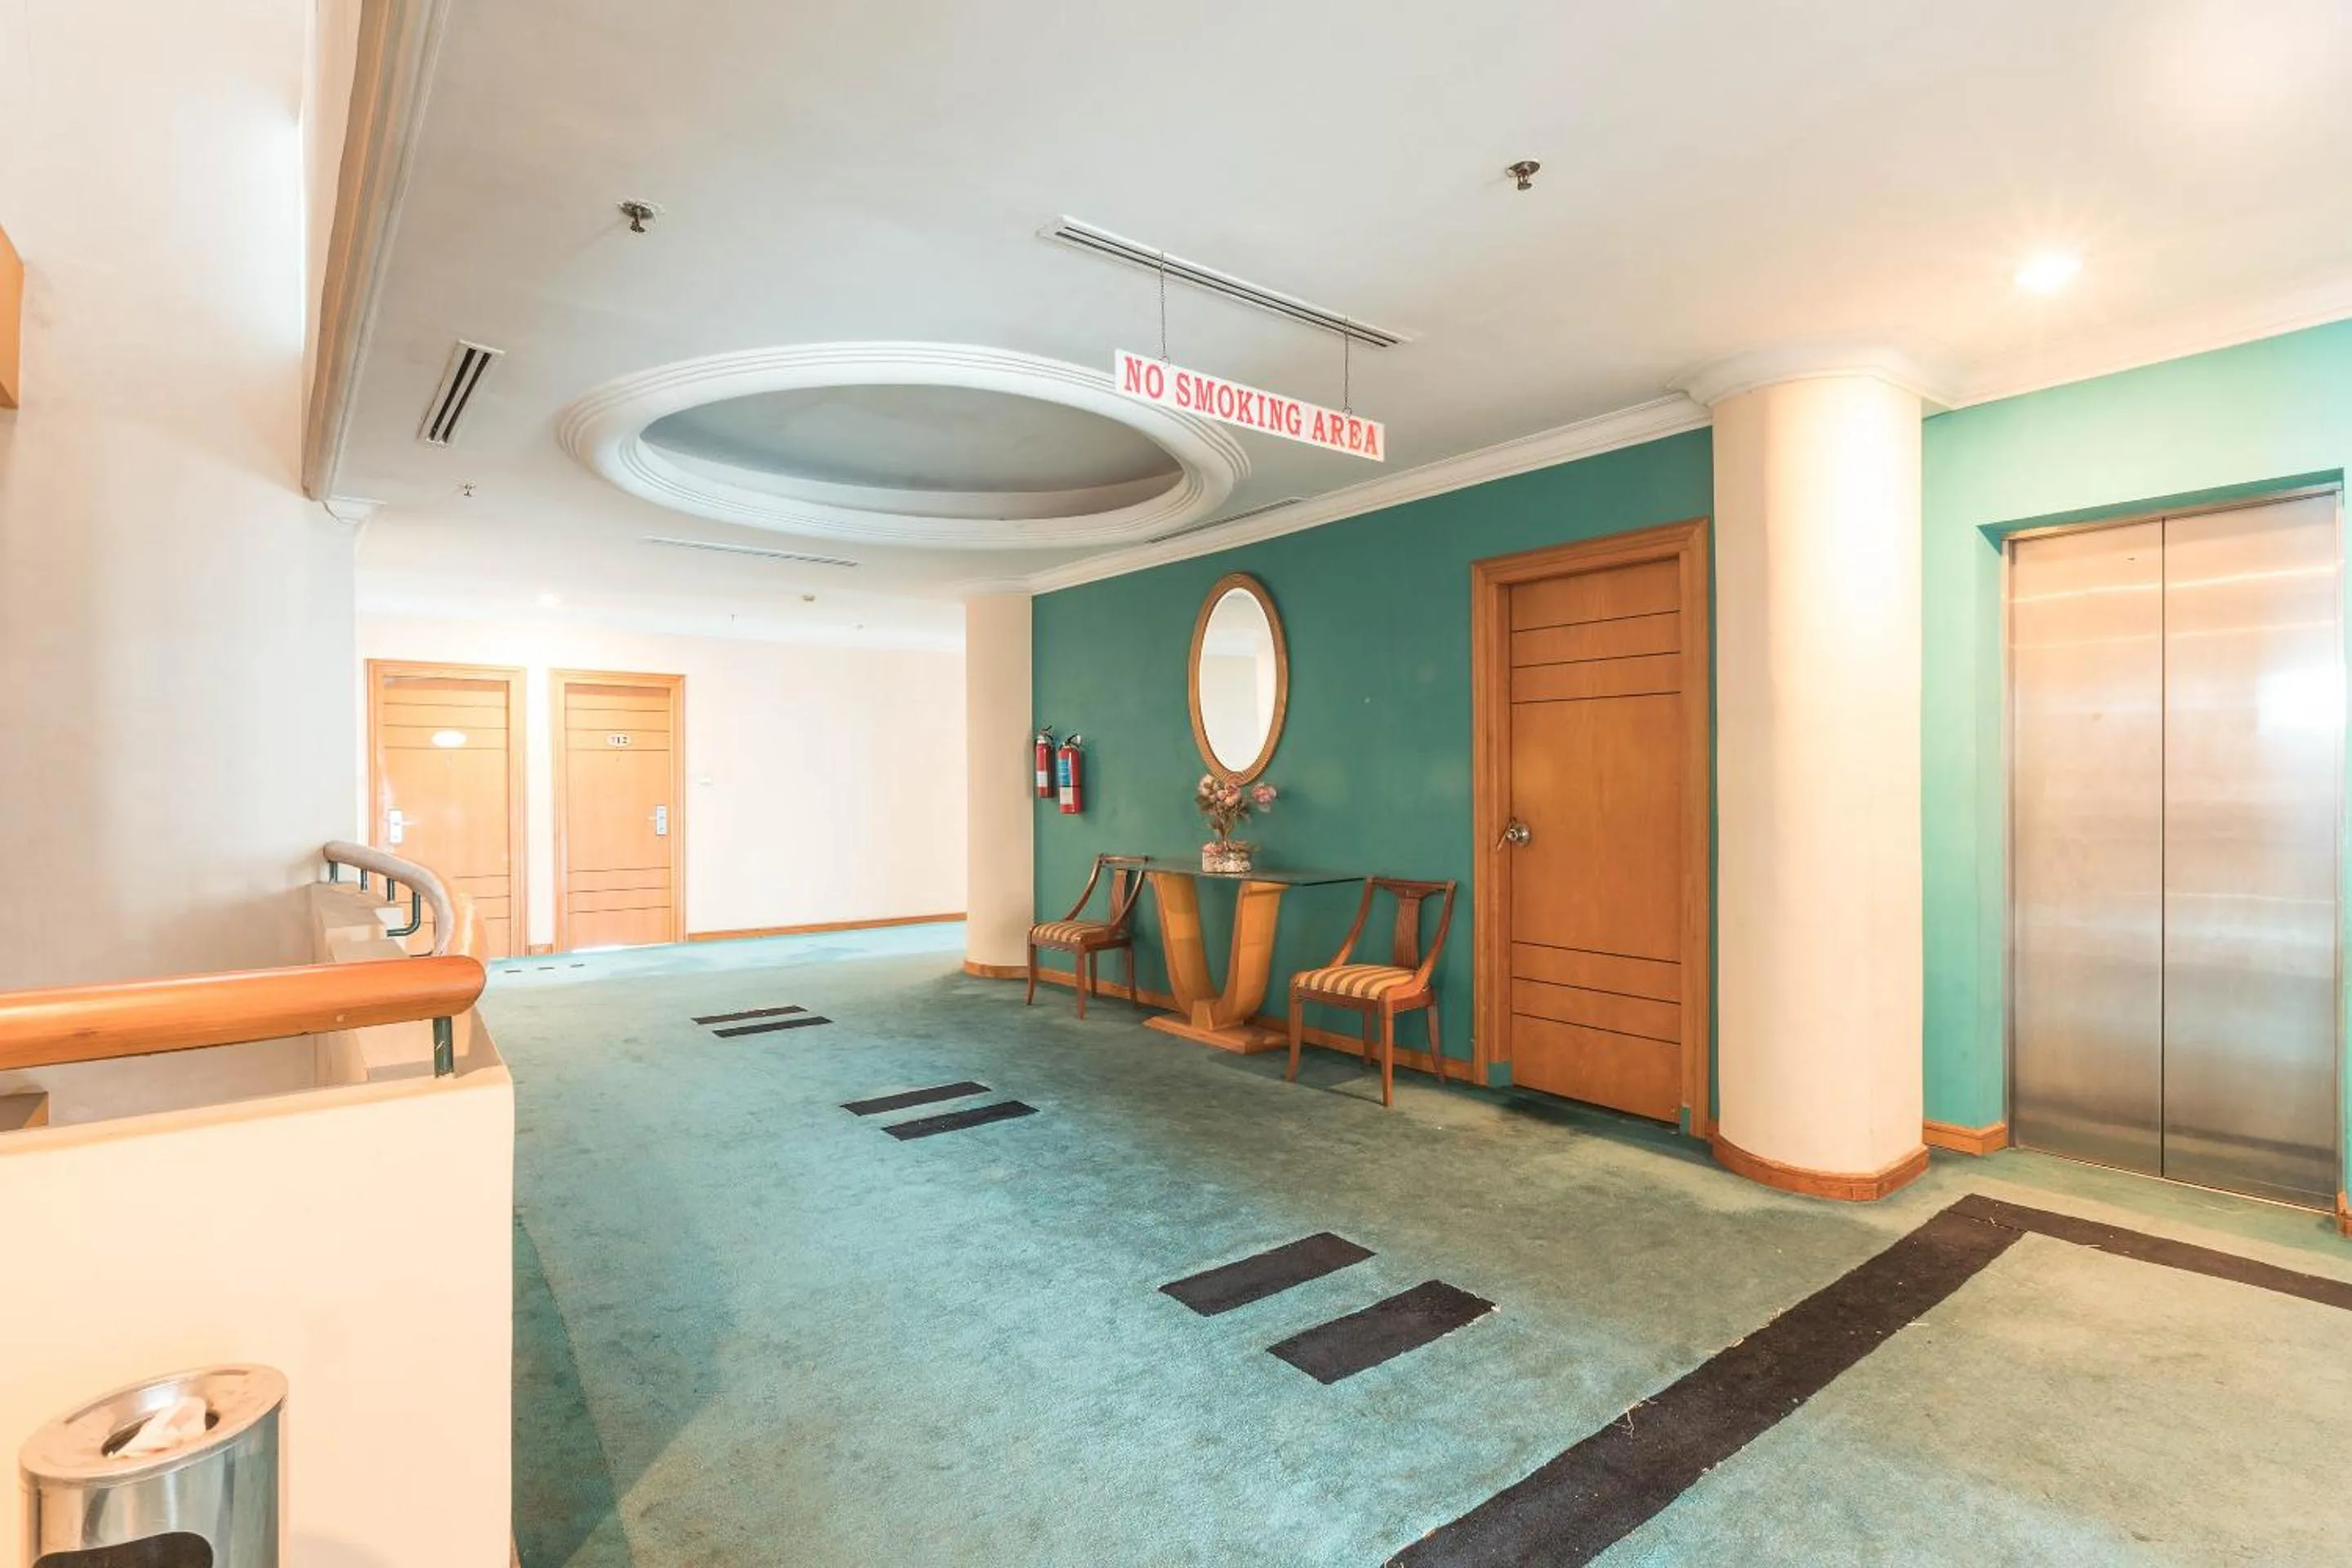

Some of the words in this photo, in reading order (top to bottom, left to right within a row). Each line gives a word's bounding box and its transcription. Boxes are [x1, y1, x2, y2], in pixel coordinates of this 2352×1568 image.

[1124, 355, 1164, 399] NO
[1175, 372, 1302, 436] SMOKING
[1312, 411, 1379, 455] AREA
